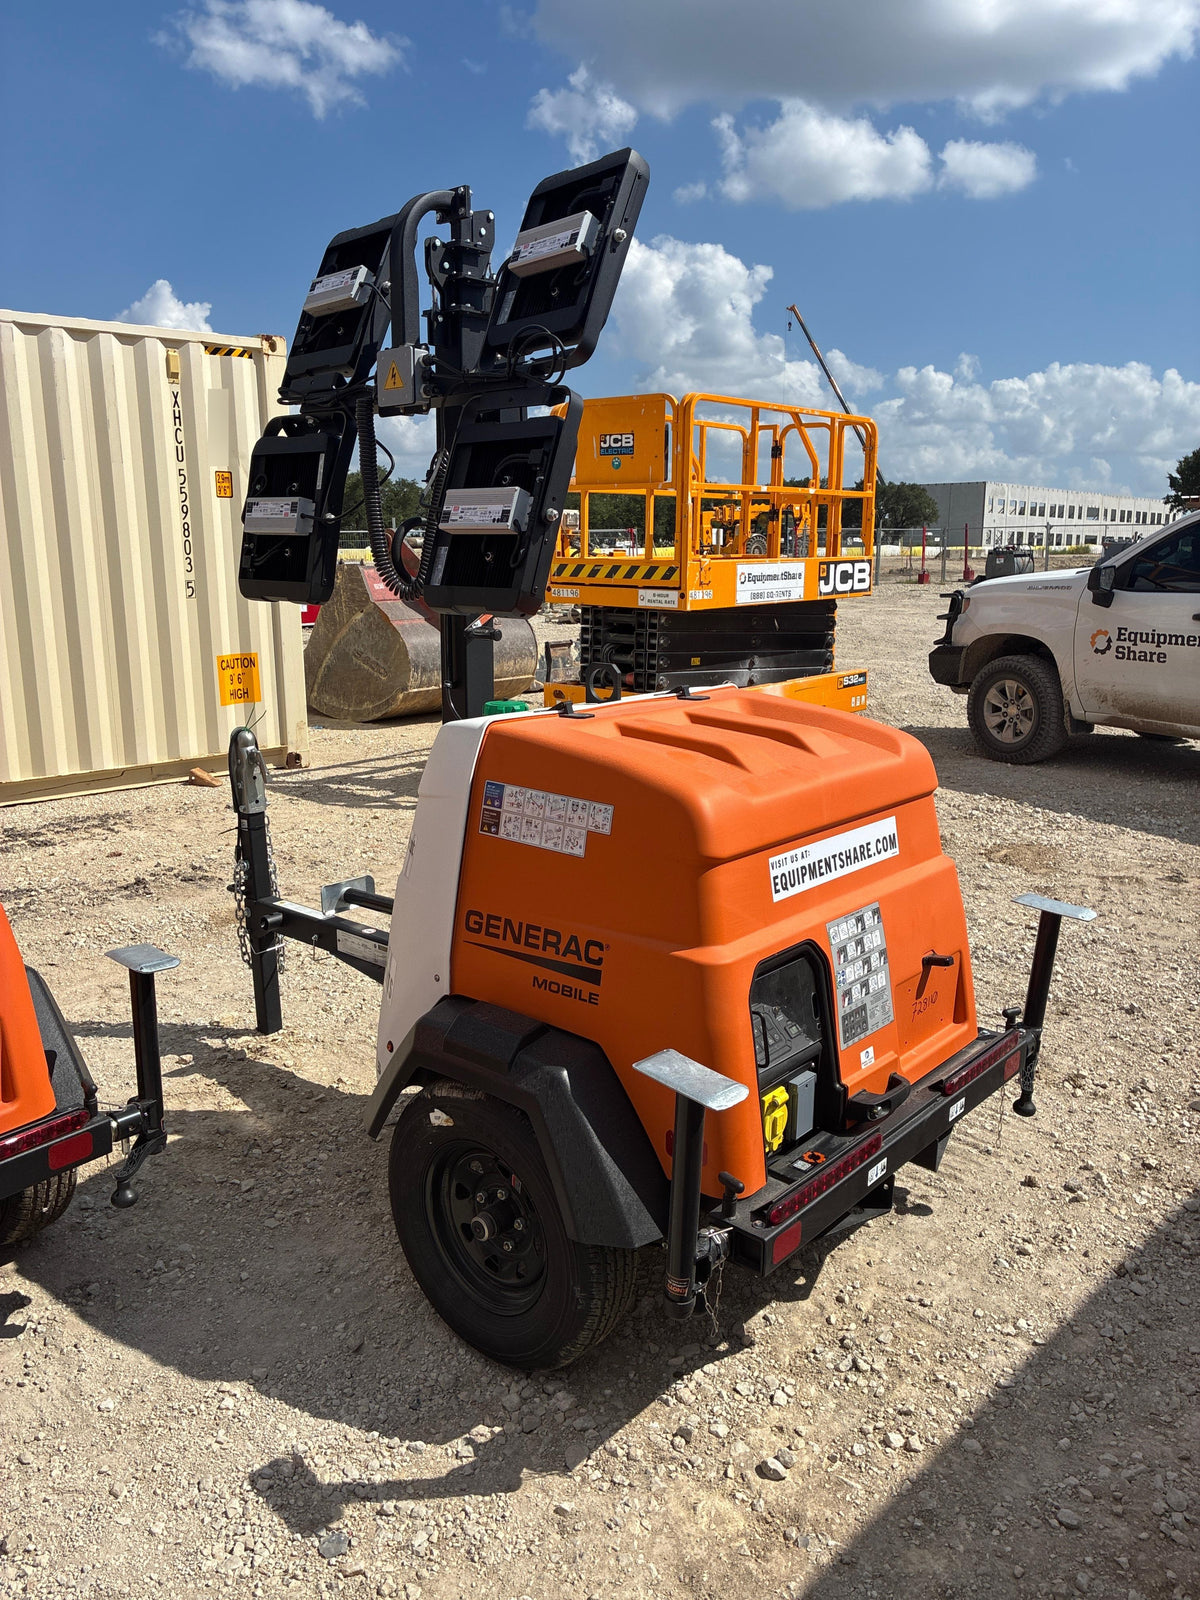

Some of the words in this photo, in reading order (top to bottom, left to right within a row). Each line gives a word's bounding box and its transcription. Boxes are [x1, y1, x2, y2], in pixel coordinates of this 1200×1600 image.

[600, 434, 634, 447] JCB
[600, 447, 634, 455] ELECTRIC
[171, 390, 185, 463] XHCU
[178, 468, 193, 573] 559803
[186, 581, 195, 598] 5
[747, 570, 803, 585] EquipmentShare
[819, 561, 871, 594] JCB
[552, 588, 579, 598] 481196
[1116, 626, 1200, 649] Equipme
[220, 656, 256, 671] CAUTION
[1115, 645, 1168, 664] Share
[229, 687, 250, 701] HIGH
[770, 857, 788, 871] VISIT
[790, 853, 799, 864] US
[801, 849, 811, 860] AT:
[772, 832, 898, 895] EQUIPMENTSHARE.COM
[532, 975, 600, 1006] MOBILE
